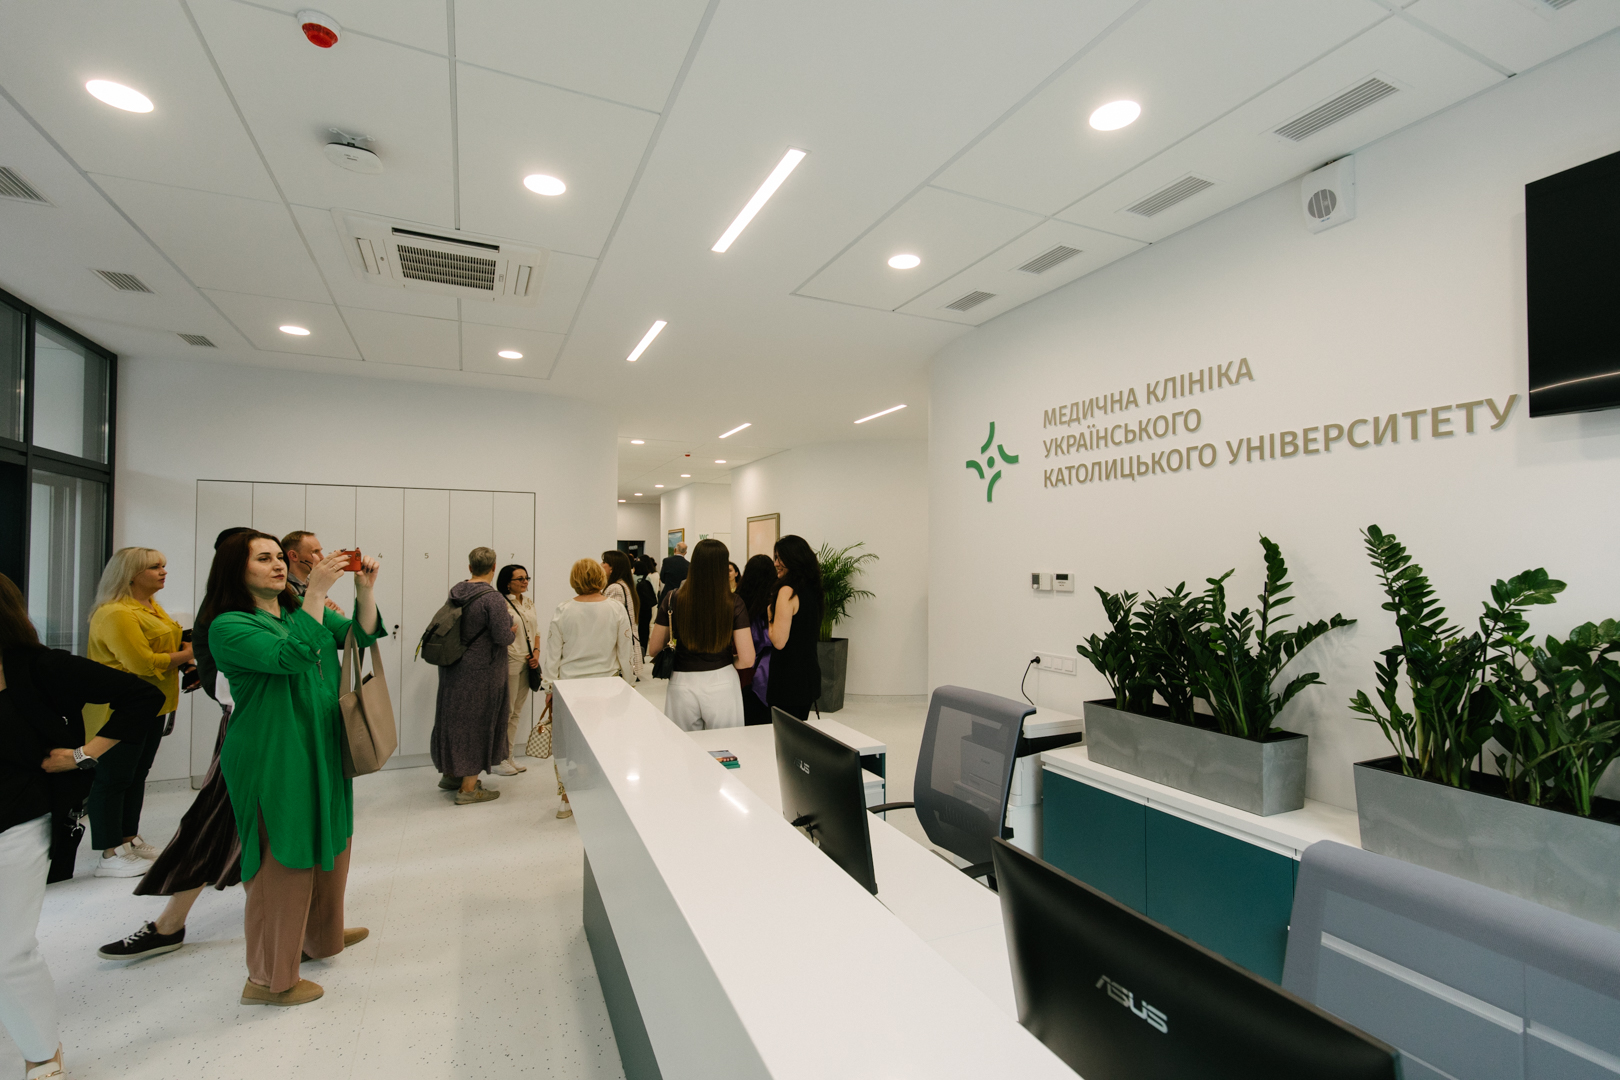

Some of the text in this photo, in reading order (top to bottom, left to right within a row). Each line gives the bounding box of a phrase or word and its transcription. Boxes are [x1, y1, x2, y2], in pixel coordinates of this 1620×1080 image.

[1043, 357, 1254, 428] МЕДИЧНА КЛІНІКА
[1043, 408, 1202, 458] УКРАЇНСЬКОГО
[1044, 394, 1518, 488] КАТОЛИЦЬКОГО УНІВЕРСИТЕТУ
[1095, 975, 1168, 1033] ASUS
